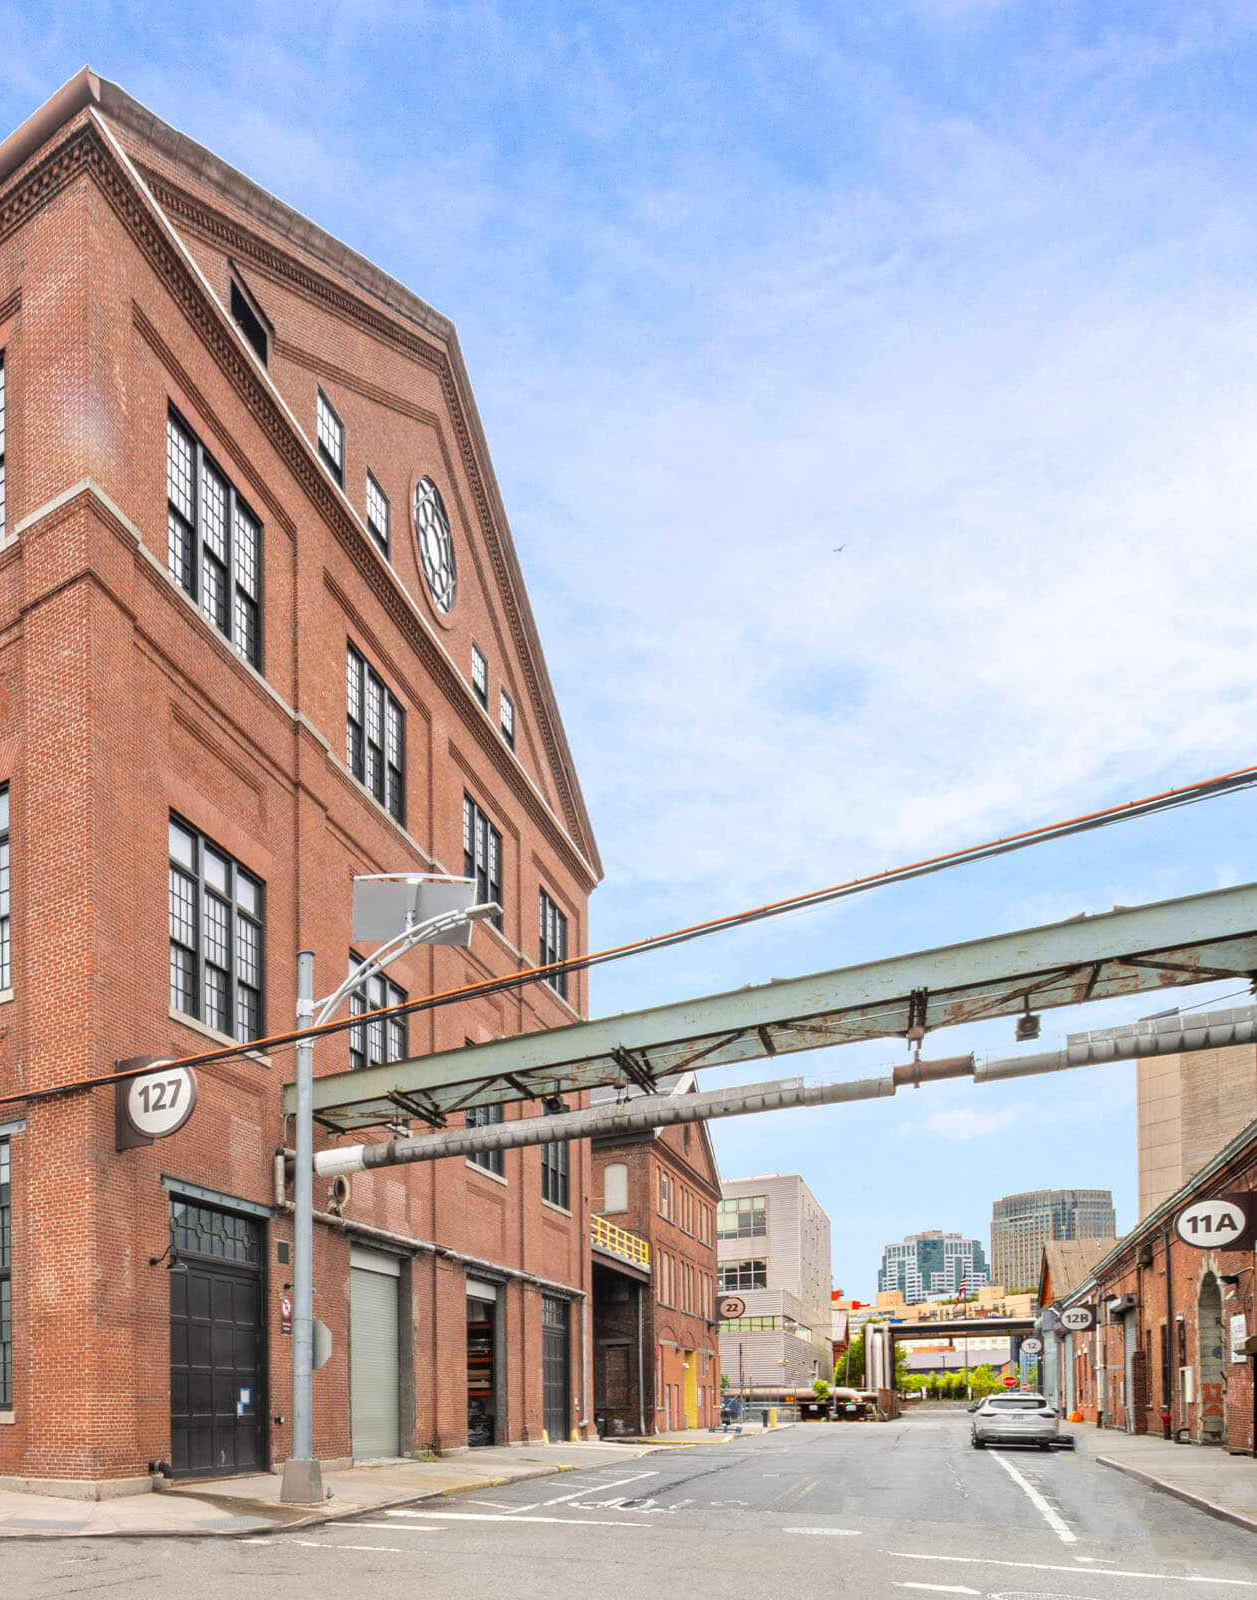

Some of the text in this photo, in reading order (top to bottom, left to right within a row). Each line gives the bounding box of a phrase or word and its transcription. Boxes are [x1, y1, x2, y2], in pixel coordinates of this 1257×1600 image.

[138, 1078, 183, 1114] 127
[1186, 1213, 1239, 1234] 11A
[725, 1303, 739, 1312] 22
[1065, 1313, 1089, 1323] 12B
[1027, 1342, 1037, 1350] 12
